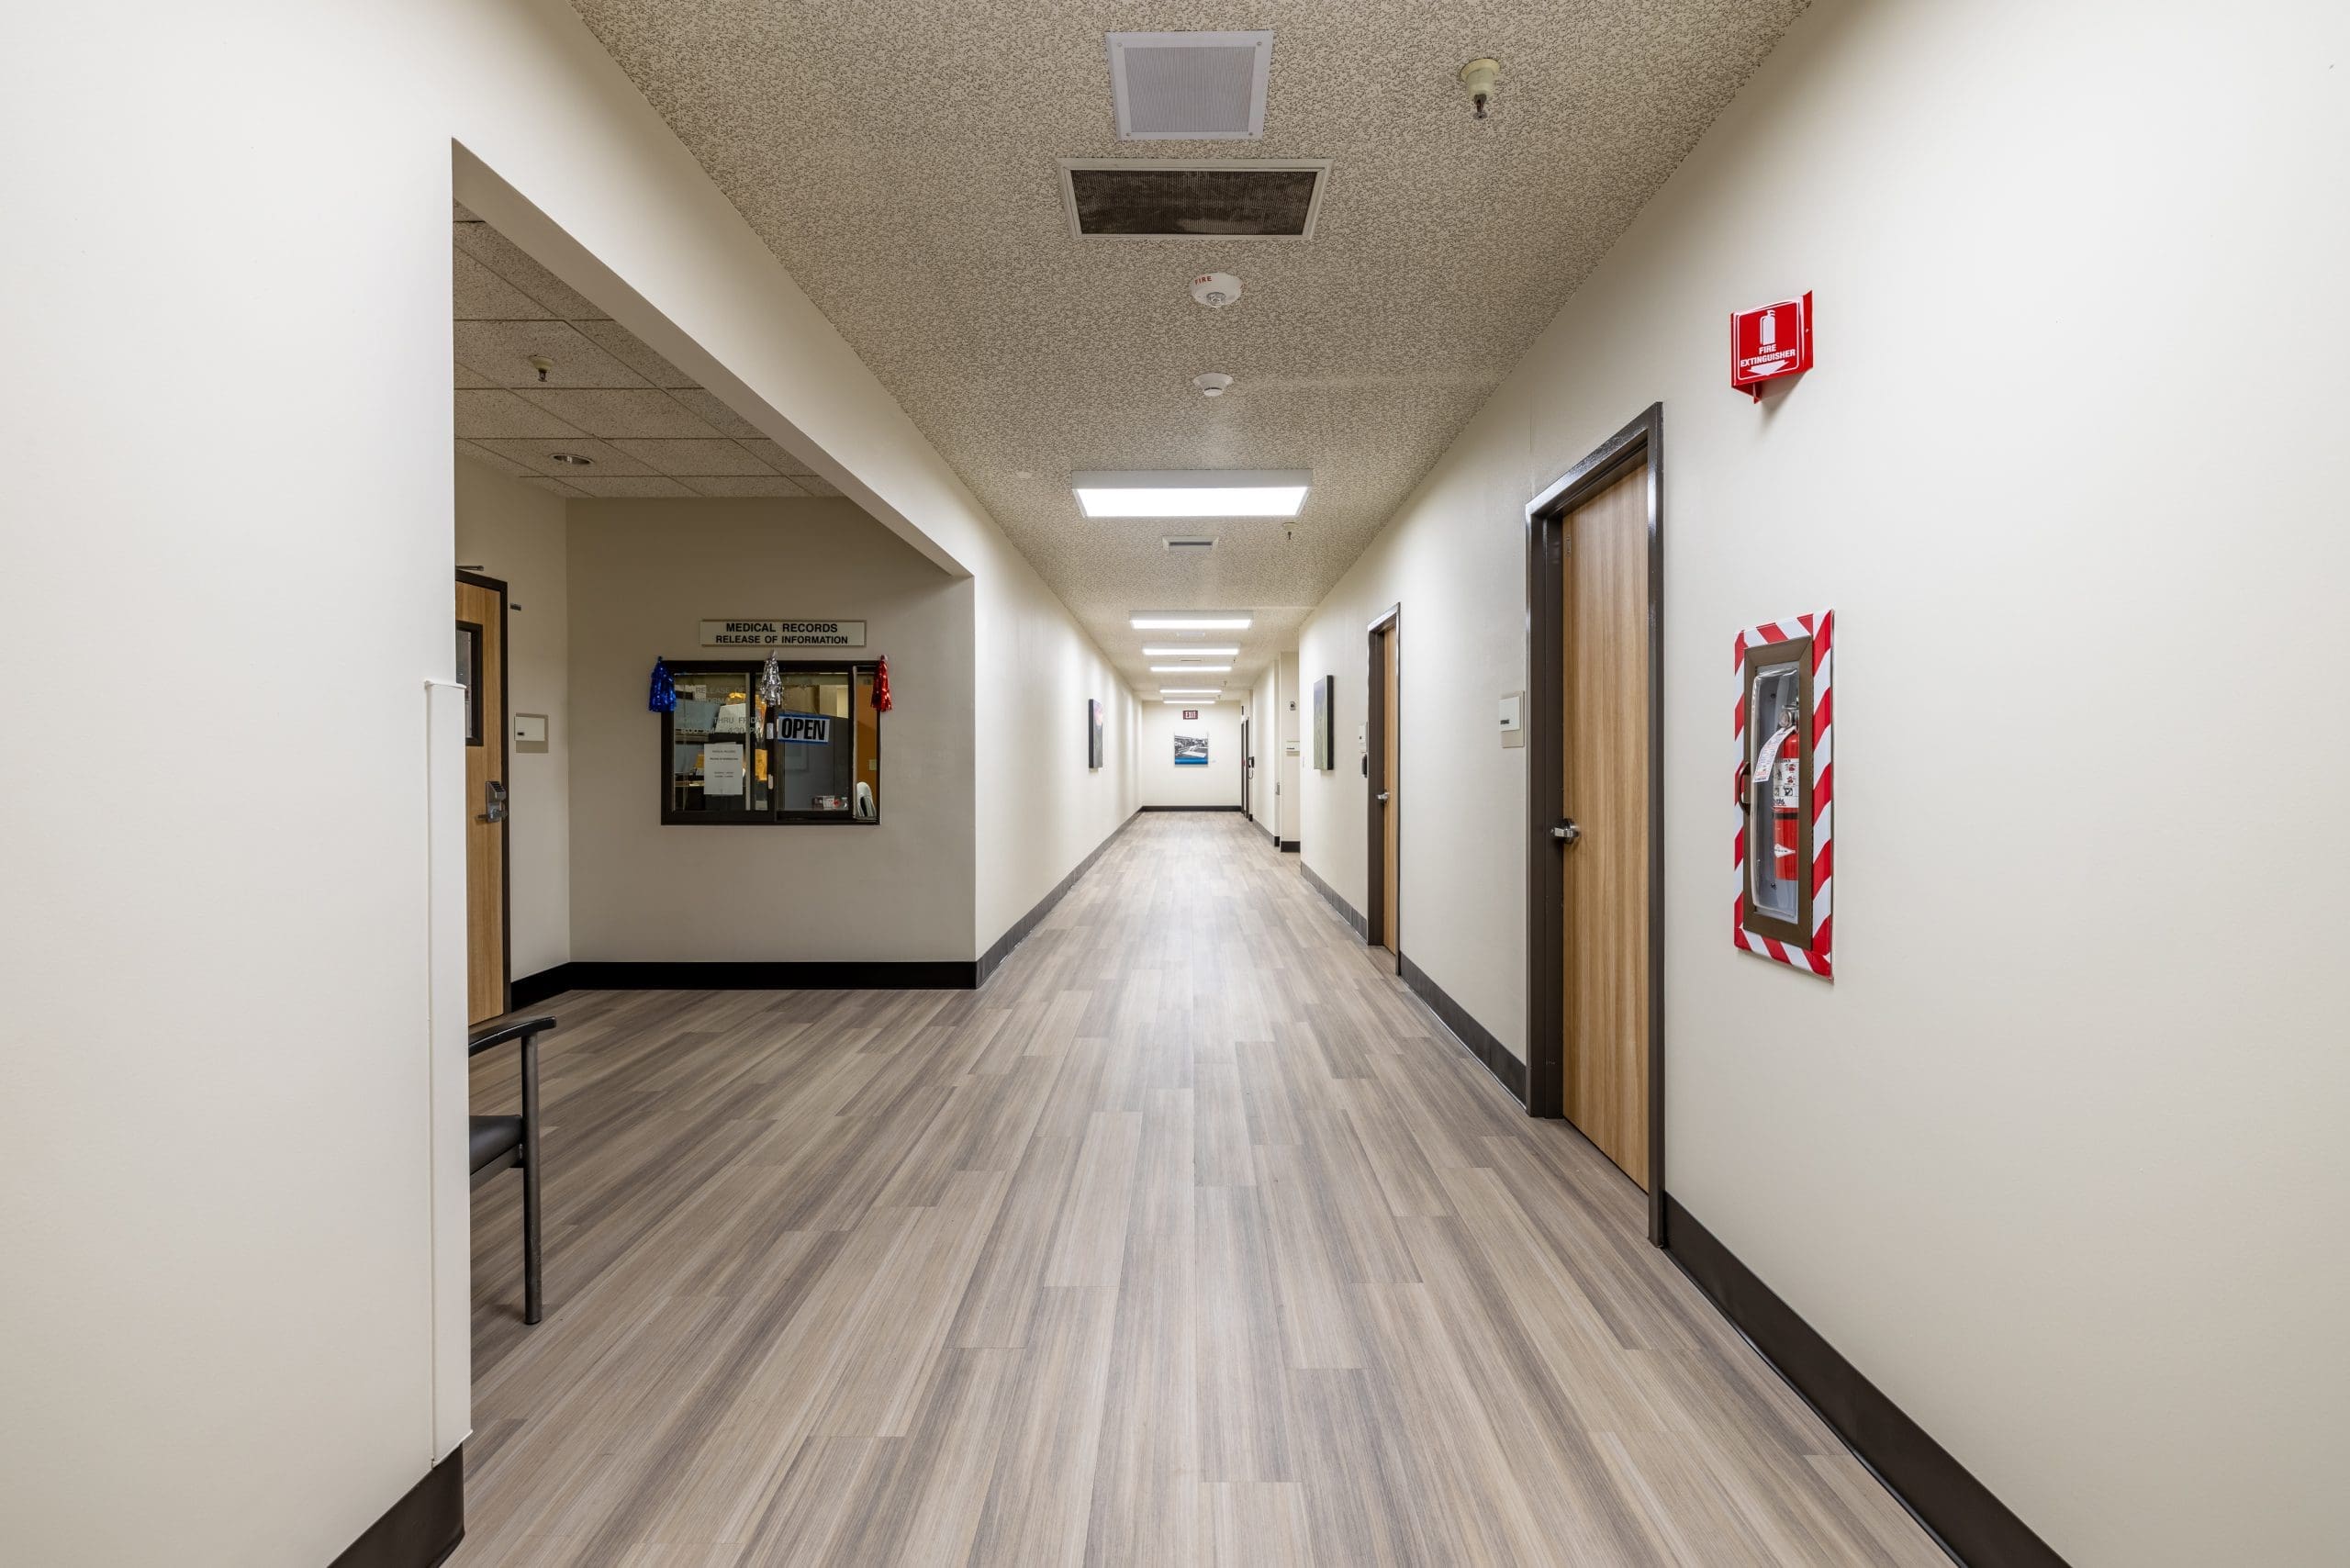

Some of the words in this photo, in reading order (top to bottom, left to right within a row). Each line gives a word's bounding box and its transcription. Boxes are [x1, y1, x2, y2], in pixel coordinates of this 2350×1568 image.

[1194, 275, 1213, 285] FIRE
[1759, 343, 1777, 355] FIRE
[1740, 349, 1796, 367] EXTINGUISHER
[726, 622, 777, 633] MEDICAL
[782, 622, 838, 633] RECORDS
[715, 634, 761, 644] RELEASE
[765, 635, 778, 644] OF
[781, 635, 848, 644] INFORMATION
[781, 717, 826, 741] OPEN
